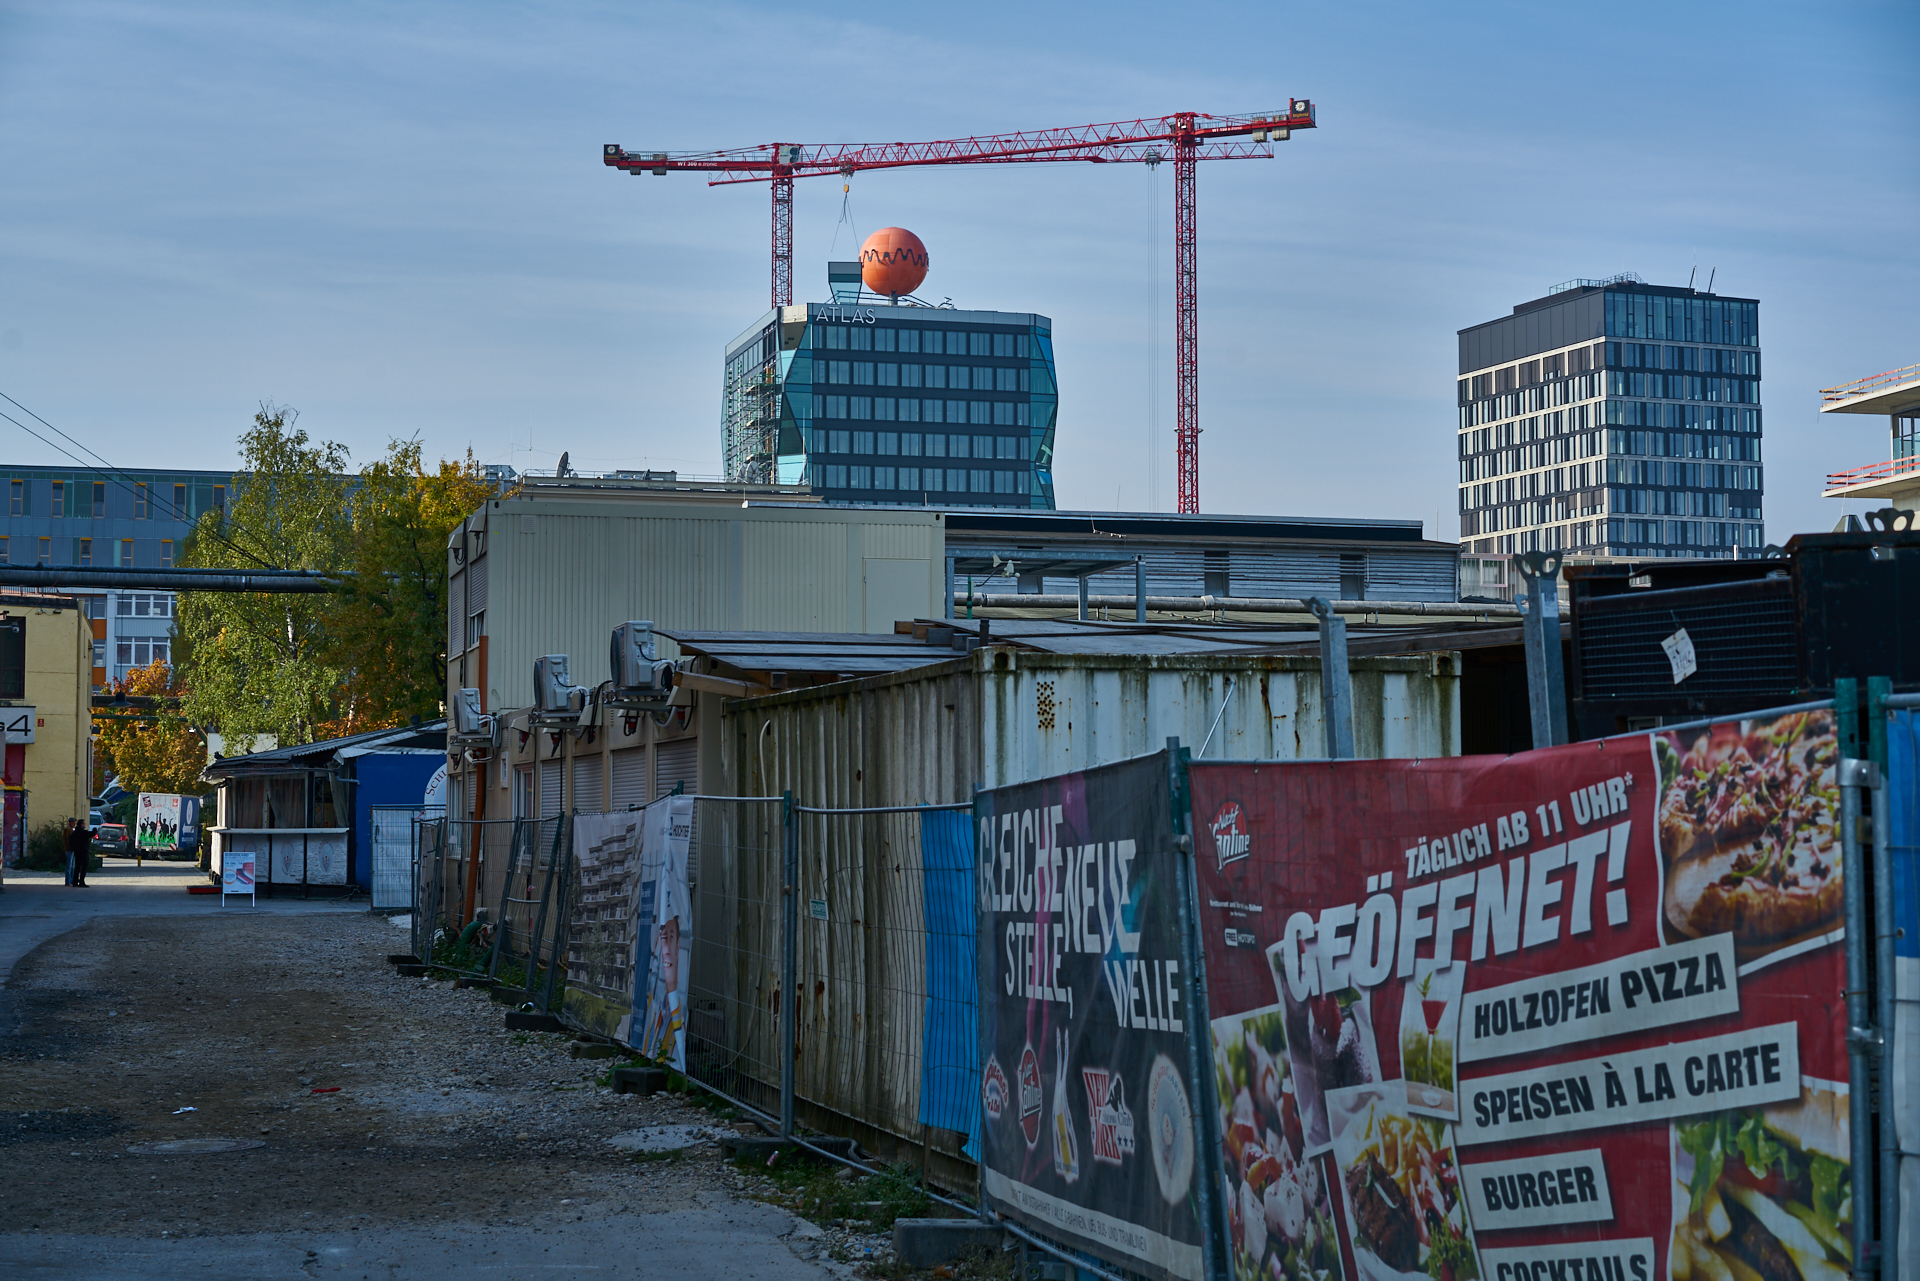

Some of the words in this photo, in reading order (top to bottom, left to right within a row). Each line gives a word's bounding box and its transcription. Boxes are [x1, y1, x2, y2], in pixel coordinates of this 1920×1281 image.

[816, 306, 876, 324] ATLAS
[6, 715, 31, 736] 4
[979, 804, 1063, 913] GLEICHE
[1405, 822, 1491, 880] TÄGLICH
[1497, 810, 1530, 851] AB
[1535, 800, 1563, 838] 11
[1062, 839, 1140, 953] NEUE
[1283, 819, 1632, 1002] GEÖFFNET!
[1005, 921, 1073, 1019] STELLE,
[1104, 959, 1183, 1033] WELLE
[1473, 975, 1609, 1040] HOLZOFEN
[1619, 951, 1727, 1010] PIZZA
[1473, 1074, 1595, 1128] SPEISEN
[1602, 1061, 1628, 1109] À
[1634, 1061, 1677, 1104] LA
[1684, 1041, 1781, 1096] CARTE
[1481, 1165, 1599, 1213] BURGER
